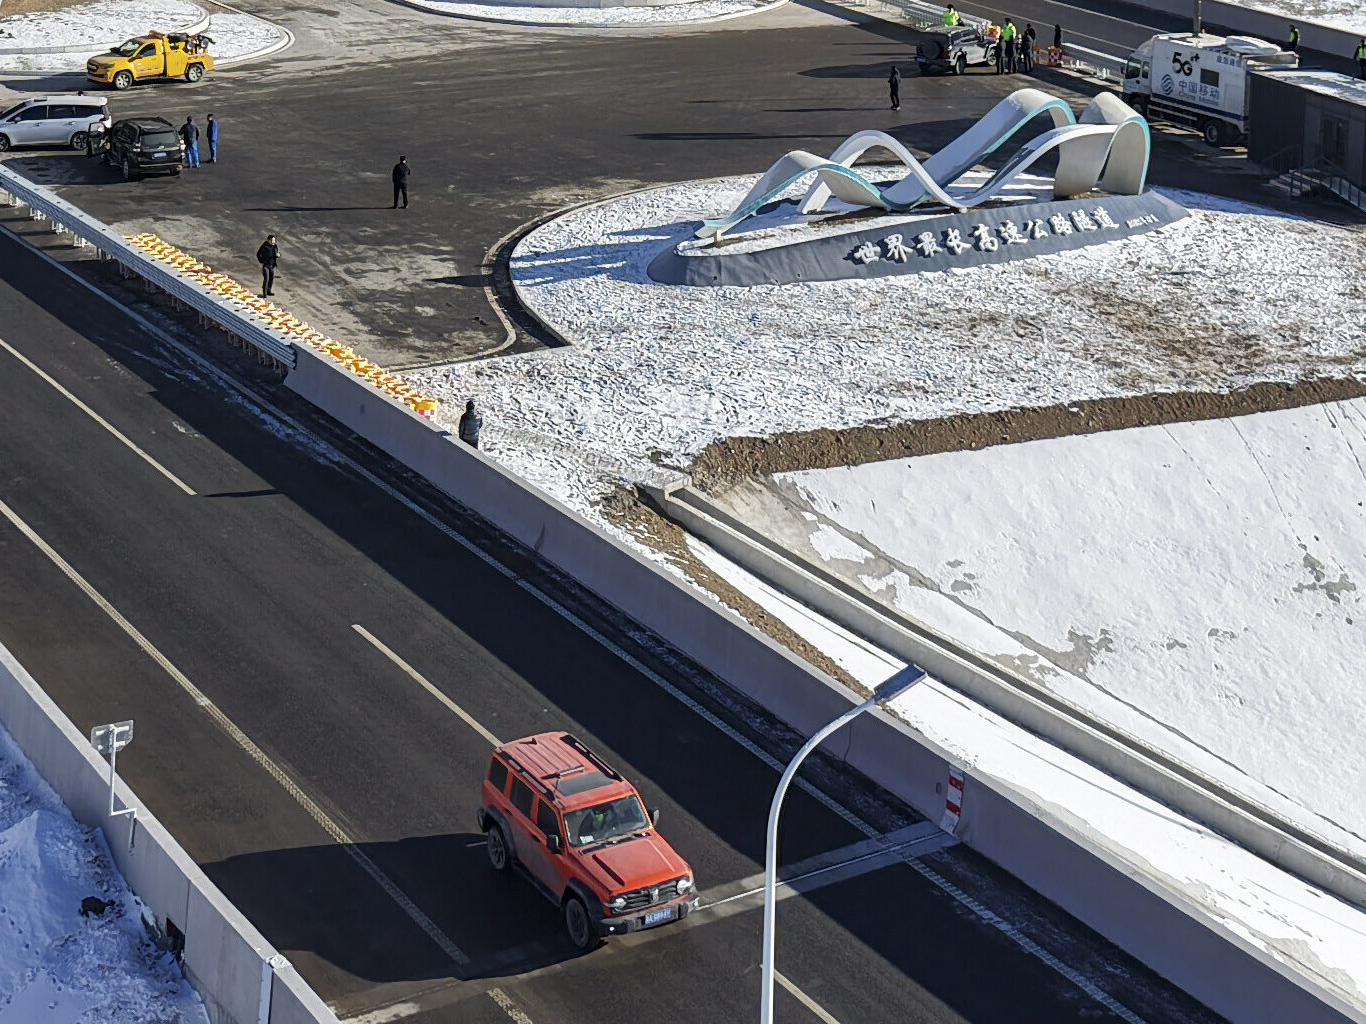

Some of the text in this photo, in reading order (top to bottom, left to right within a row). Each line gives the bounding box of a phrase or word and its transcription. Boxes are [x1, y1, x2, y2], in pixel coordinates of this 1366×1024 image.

[1178, 79, 1220, 101] 中国移动
[854, 205, 1120, 265] 世界最长高速公路隧道
